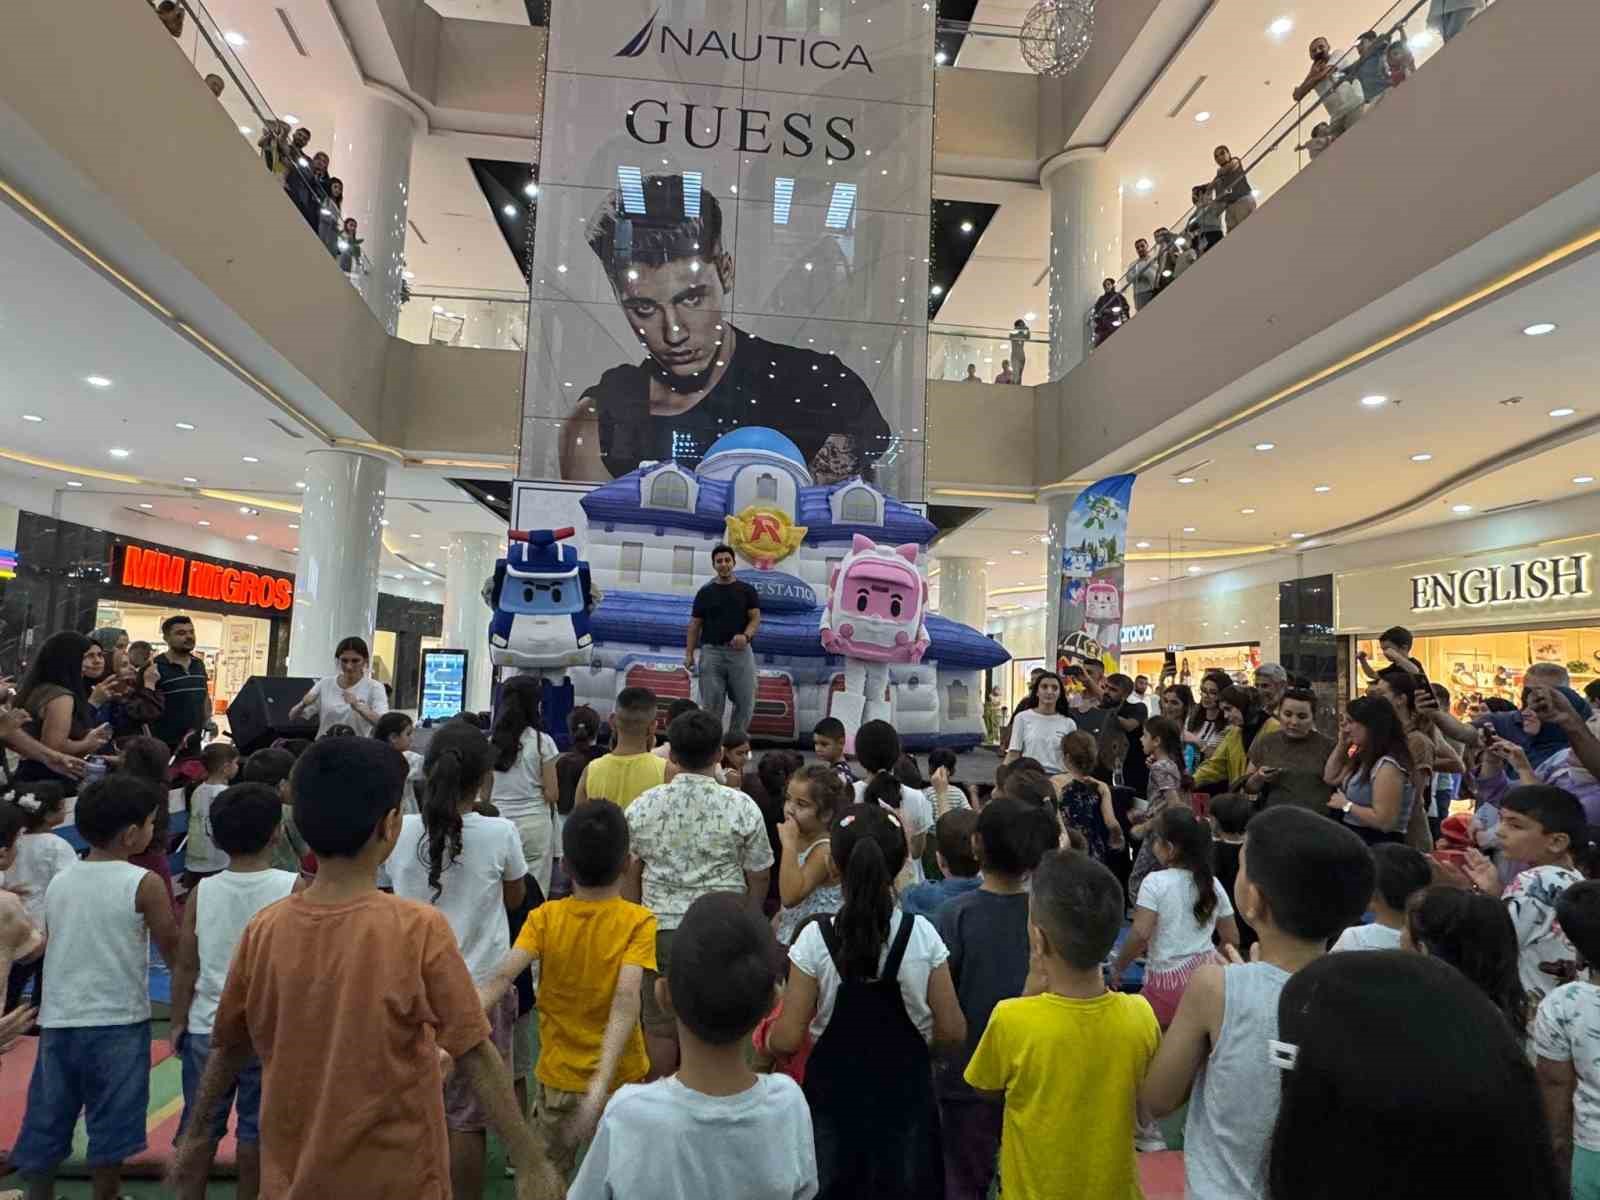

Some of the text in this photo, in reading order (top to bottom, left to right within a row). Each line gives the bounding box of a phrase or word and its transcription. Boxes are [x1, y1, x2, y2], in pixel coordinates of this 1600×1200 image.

[661, 25, 874, 73] NAUTICA
[625, 99, 857, 161] GUESS
[122, 545, 185, 594] MM
[1409, 554, 1590, 611] ENGLISH
